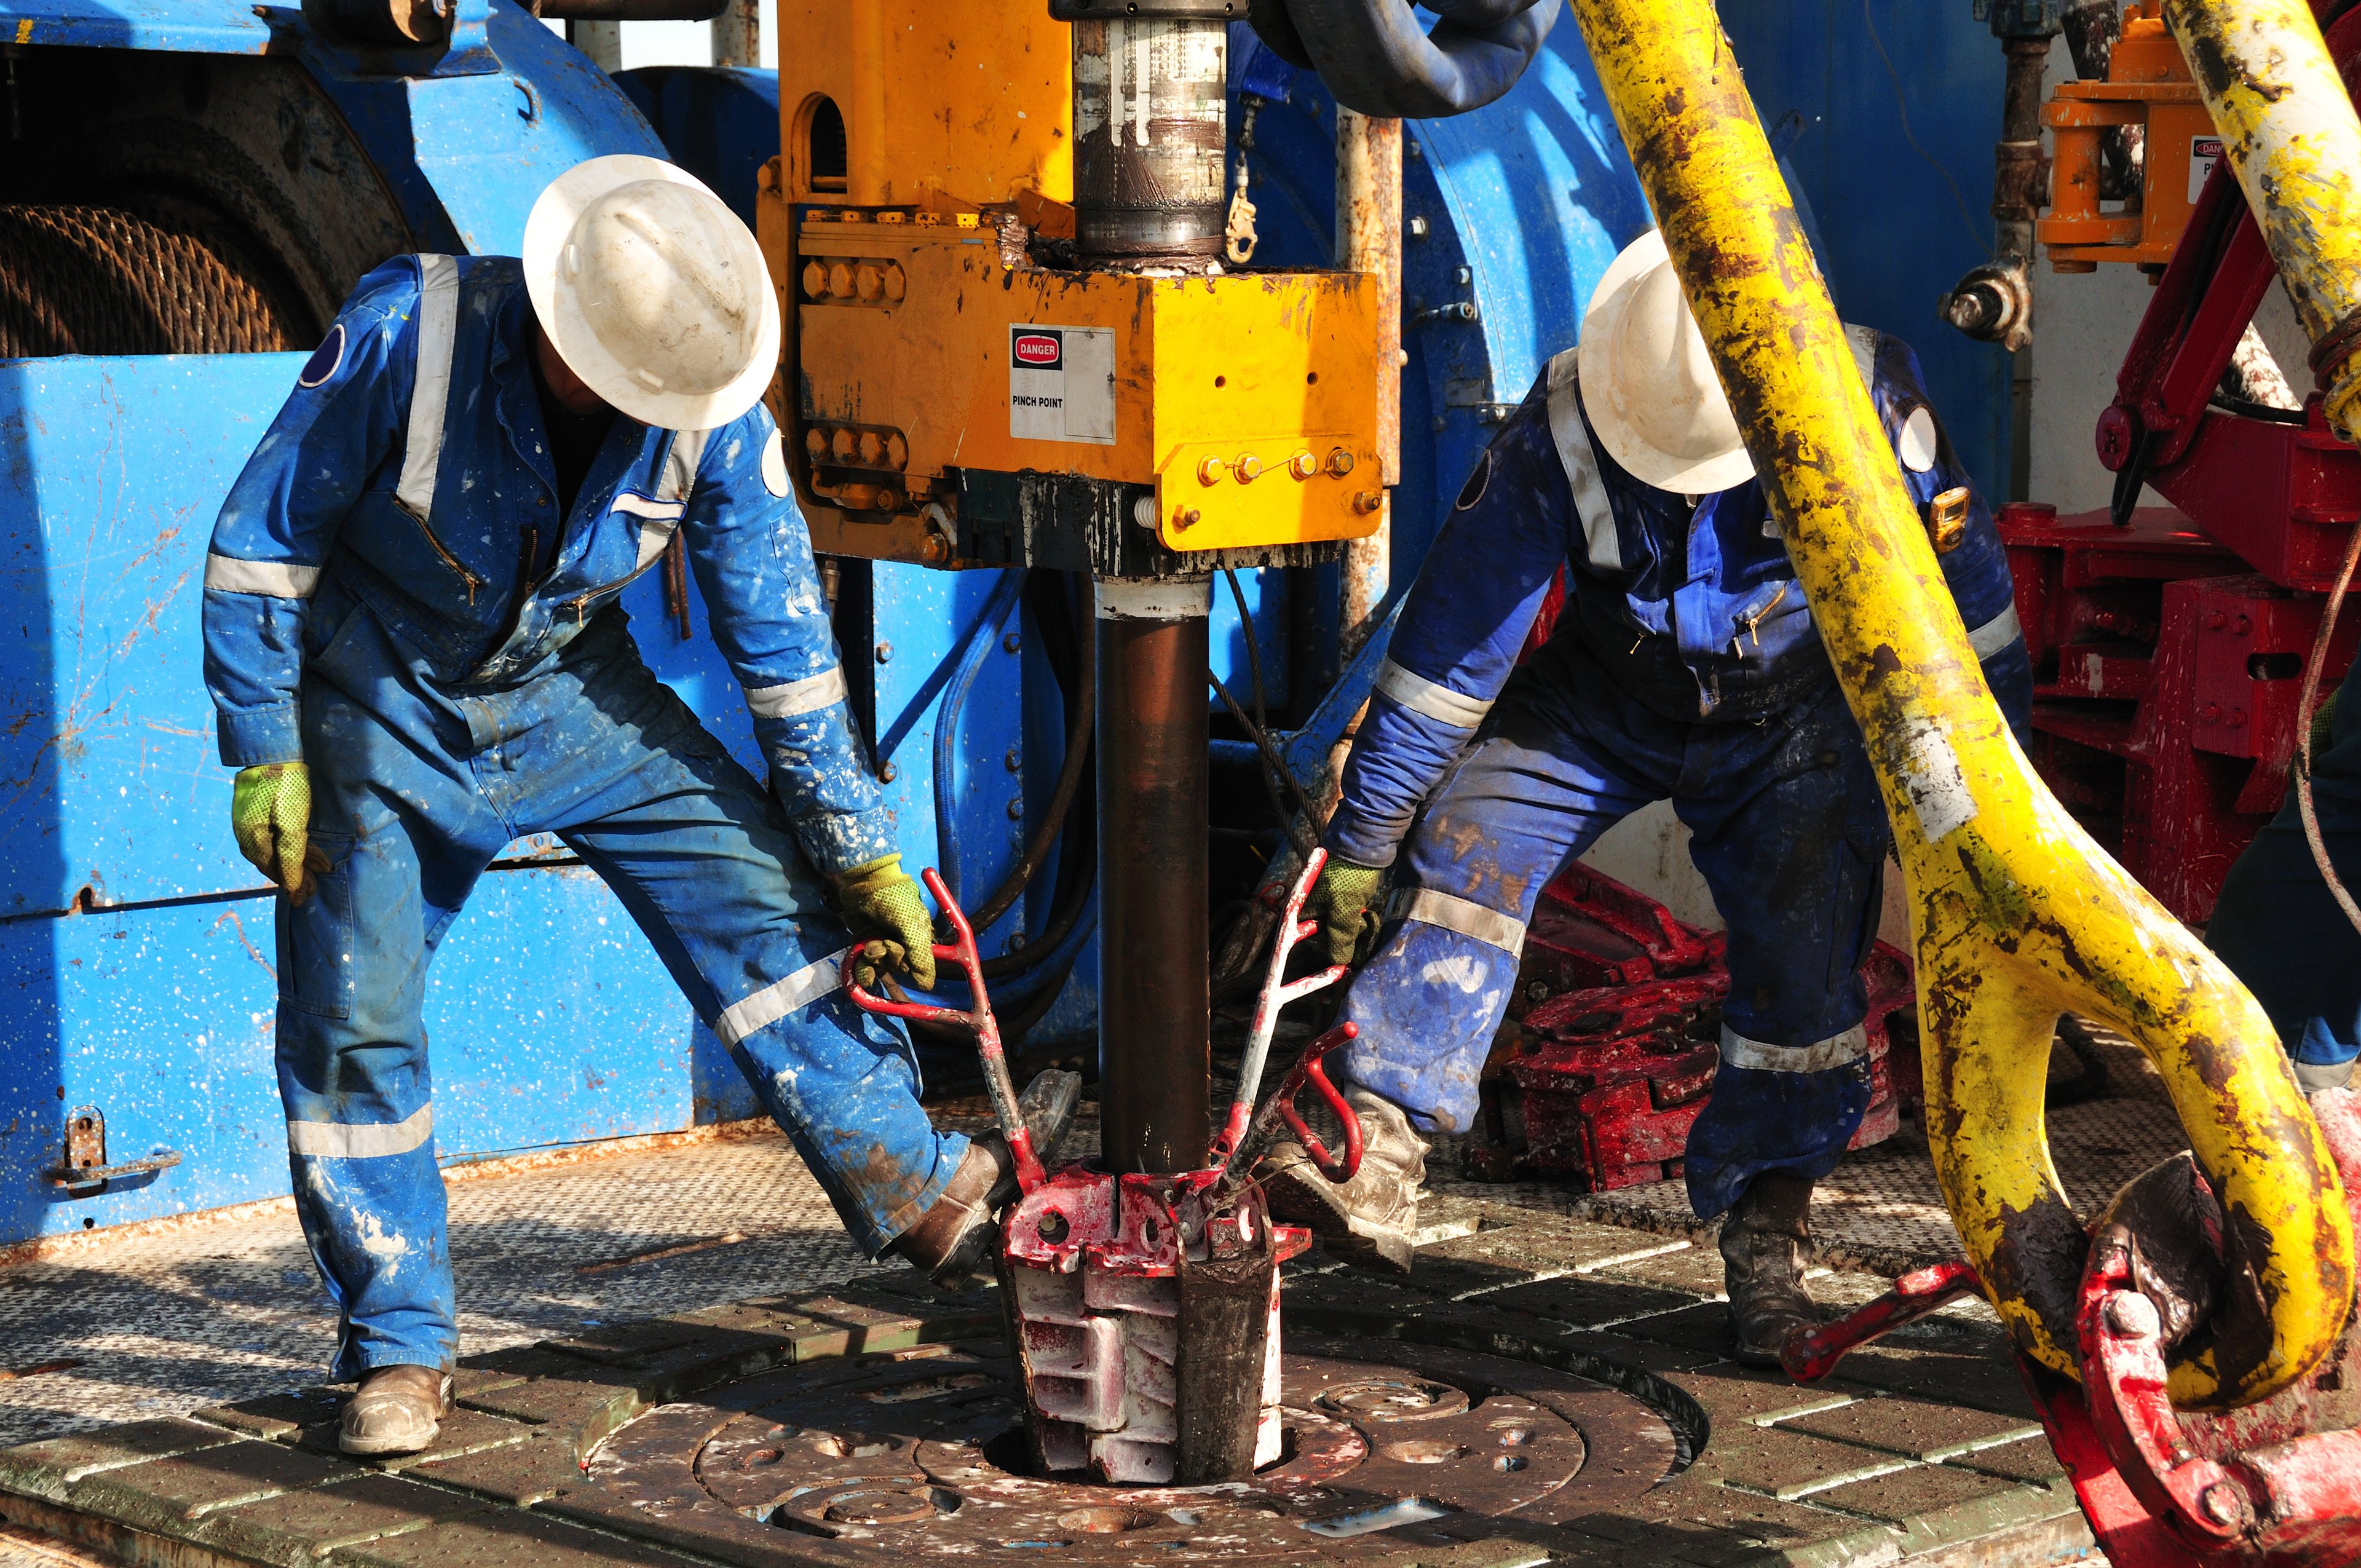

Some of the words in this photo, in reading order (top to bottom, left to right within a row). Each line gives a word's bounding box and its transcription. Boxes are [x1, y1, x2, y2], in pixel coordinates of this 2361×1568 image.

[1021, 344, 1055, 355] DANGER
[1013, 395, 1037, 406] PINCH
[1039, 397, 1062, 408] POINT
